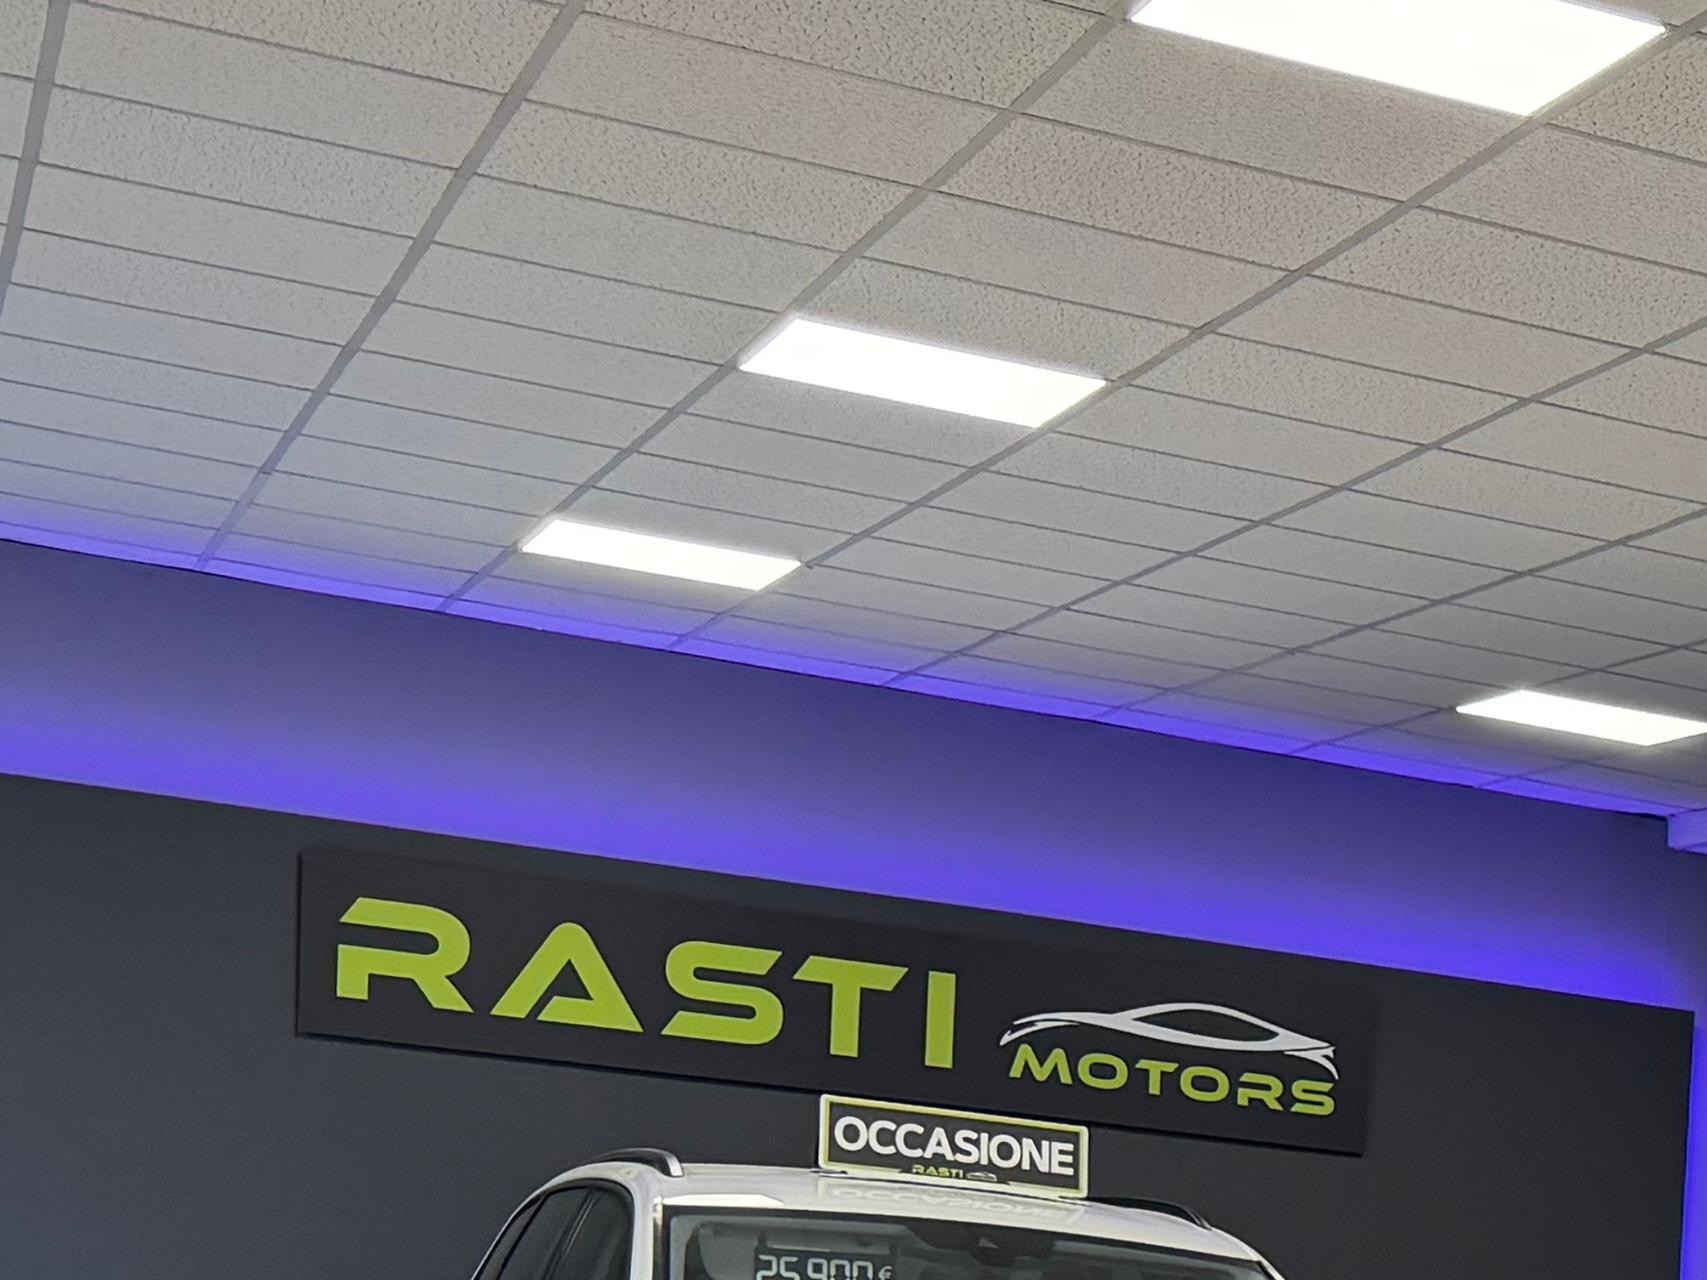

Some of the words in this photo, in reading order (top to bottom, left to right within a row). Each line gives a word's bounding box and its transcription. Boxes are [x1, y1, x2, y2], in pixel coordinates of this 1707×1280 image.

[336, 897, 957, 1068] RASTI
[1008, 1043, 1336, 1116] MOTORS
[834, 1116, 1075, 1176] OCCASIONE
[912, 1164, 963, 1178] RASTI
